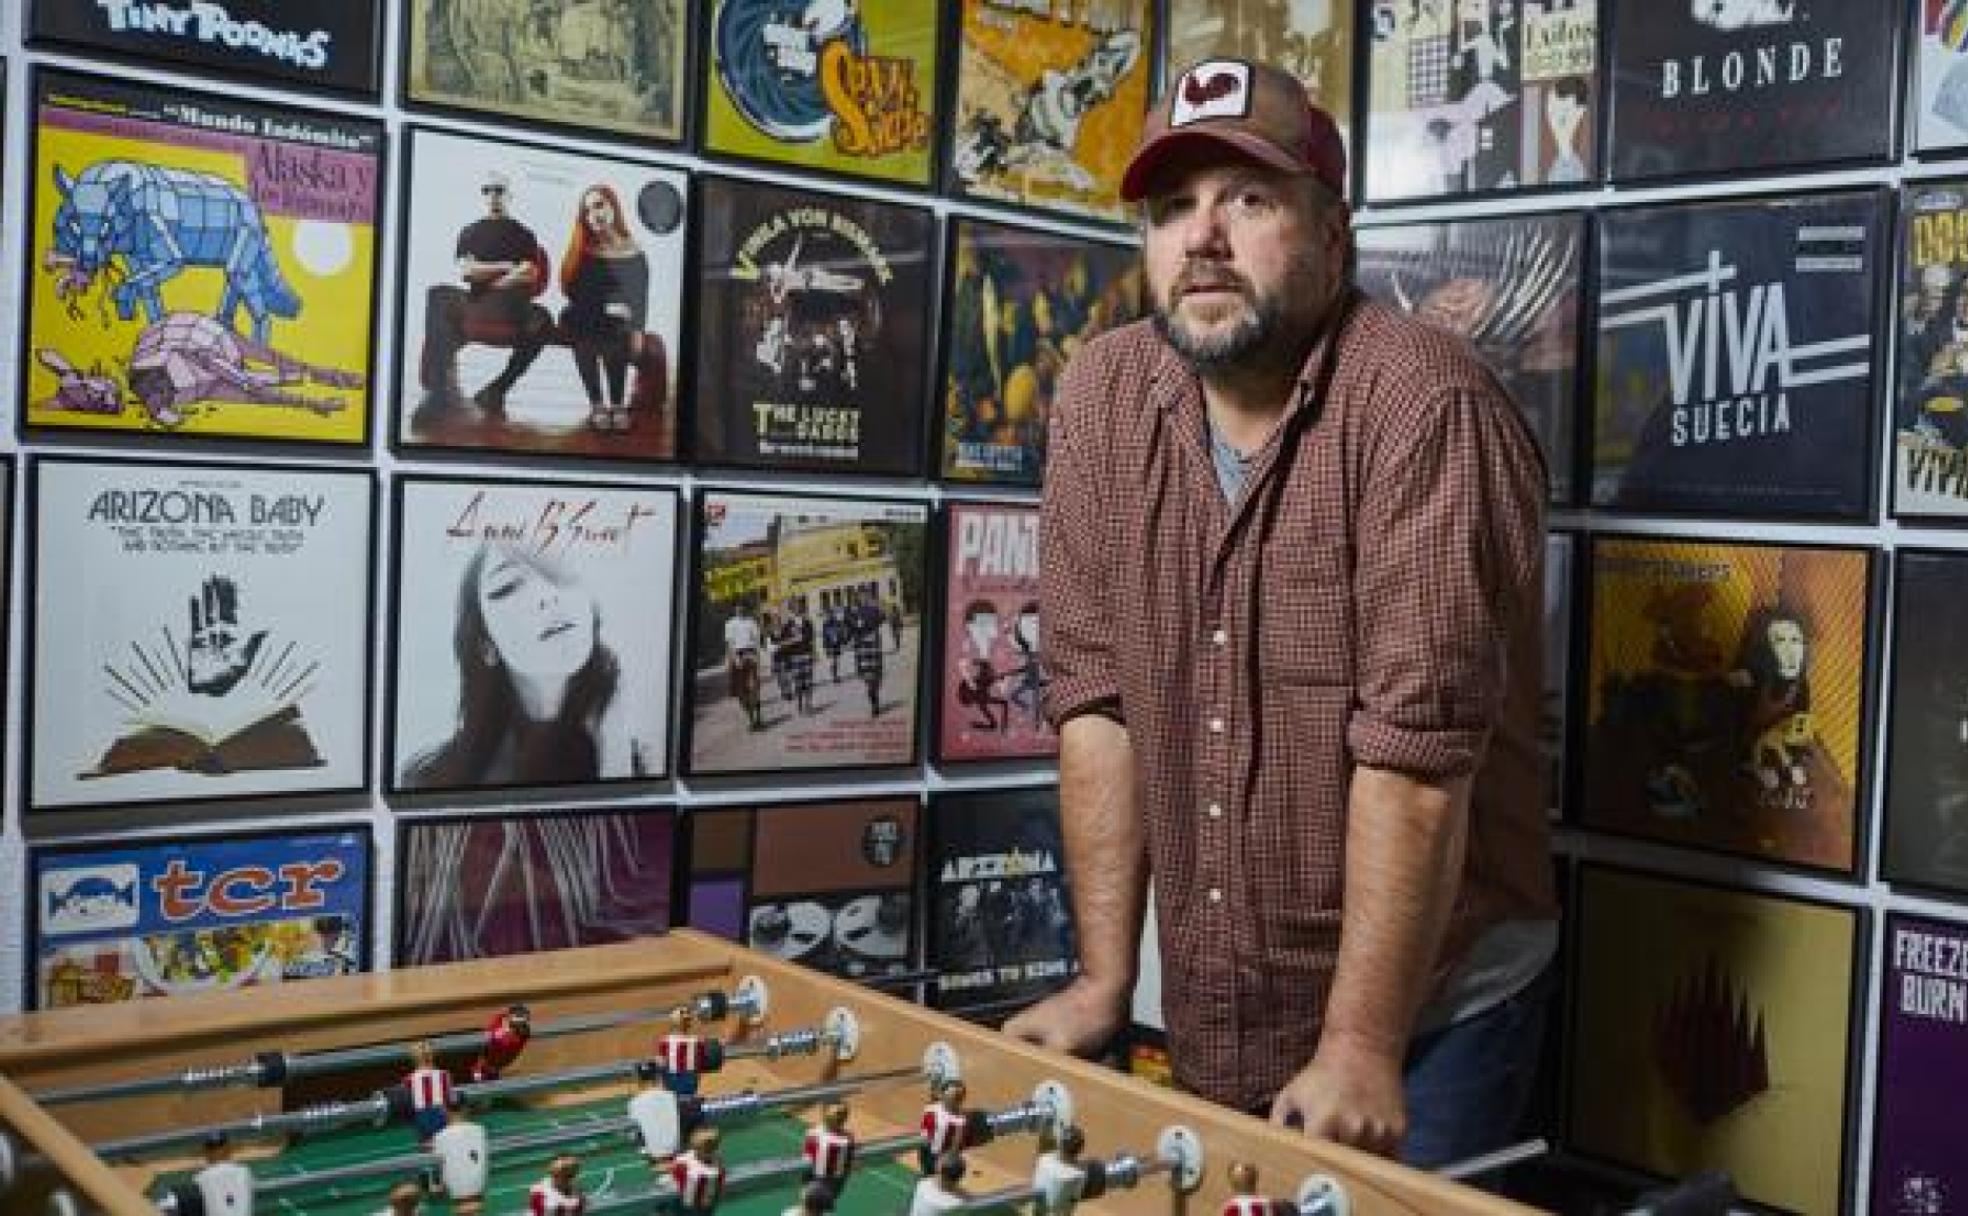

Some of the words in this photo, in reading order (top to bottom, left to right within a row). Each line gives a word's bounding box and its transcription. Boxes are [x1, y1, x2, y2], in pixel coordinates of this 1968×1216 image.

[1661, 37, 1844, 99] BLONDE
[1661, 250, 1792, 406] VIVA
[1671, 393, 1791, 447] SUECIA
[86, 488, 236, 524] ARIZONA
[250, 494, 325, 527] BABY
[153, 857, 345, 921] tcr
